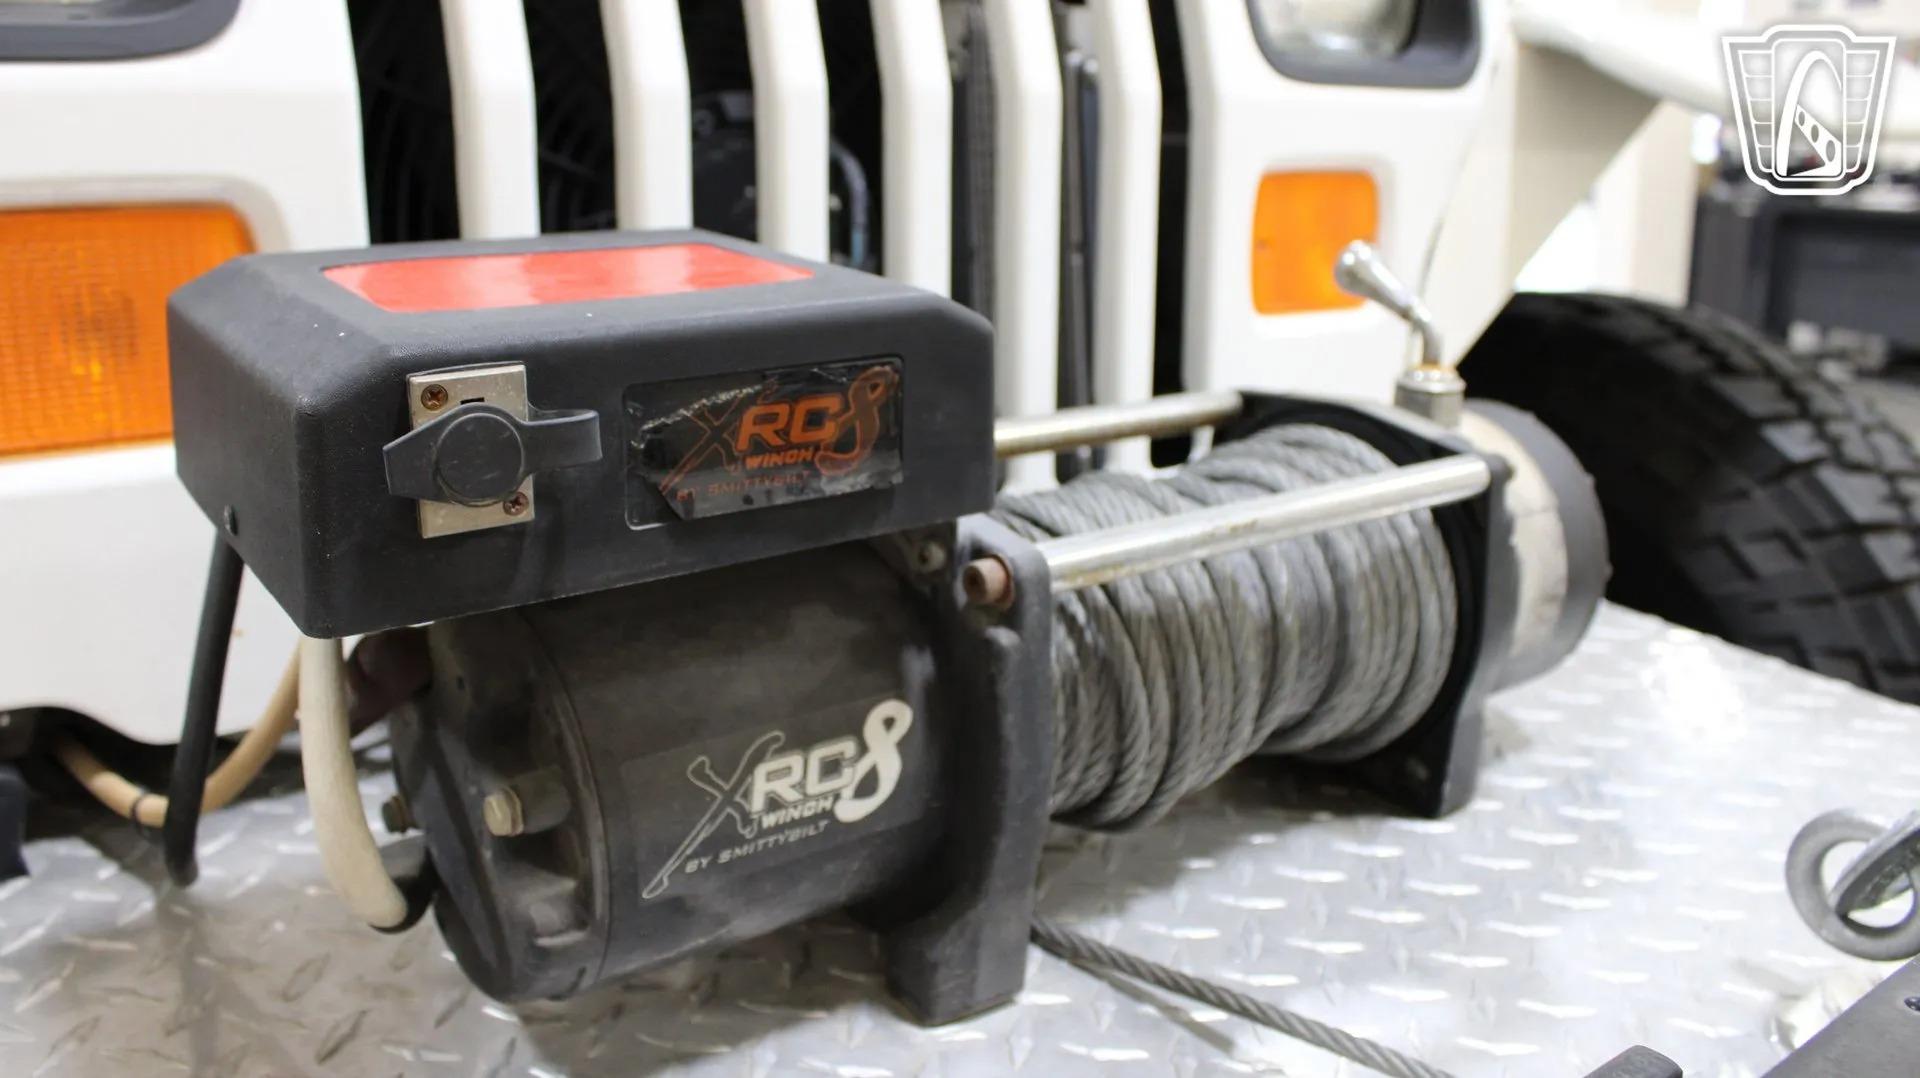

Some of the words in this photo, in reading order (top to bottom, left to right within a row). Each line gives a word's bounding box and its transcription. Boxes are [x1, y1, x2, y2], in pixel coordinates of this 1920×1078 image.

[745, 446, 815, 470] WINCH
[677, 486, 697, 502] BY
[708, 471, 810, 496] SMITTYBILT
[760, 795, 836, 829] WINCH
[685, 855, 712, 873] BY
[717, 819, 830, 864] SMITTYBILT
